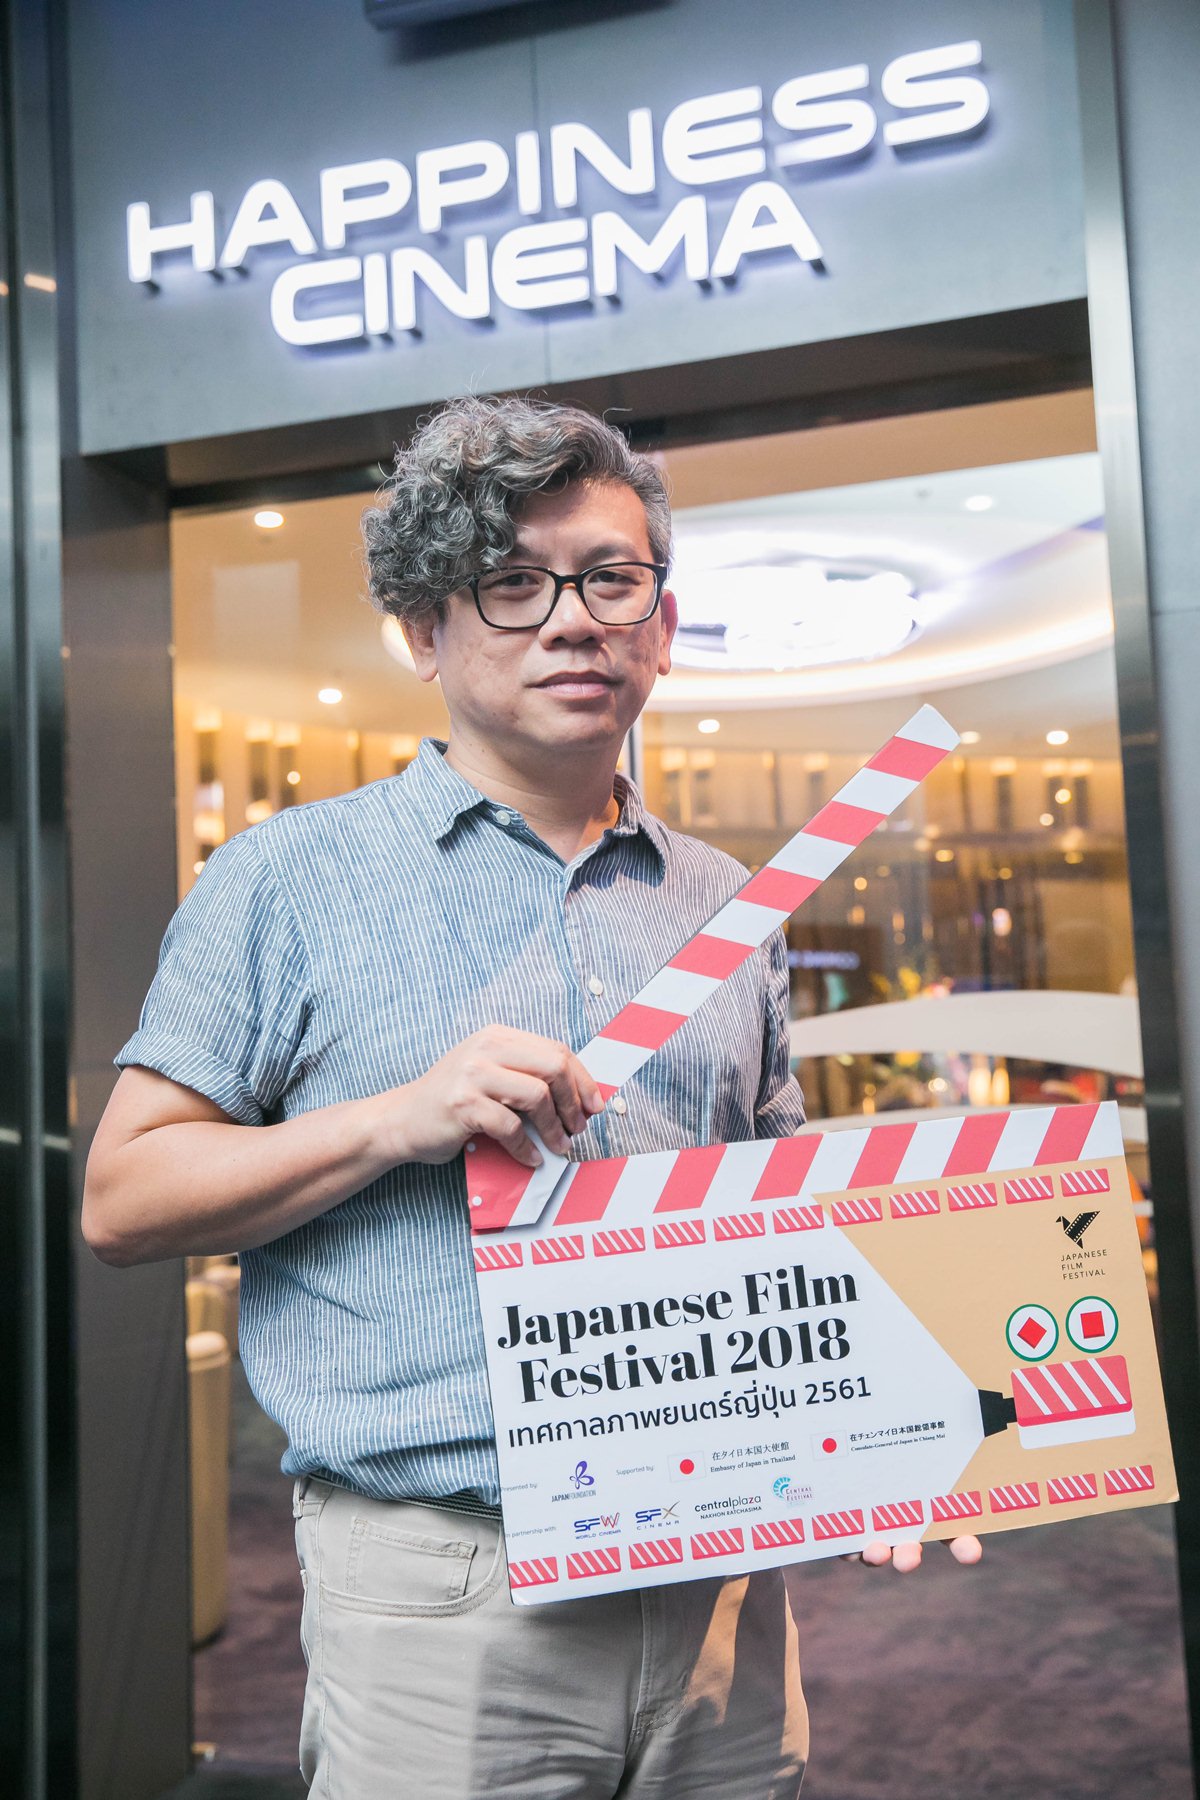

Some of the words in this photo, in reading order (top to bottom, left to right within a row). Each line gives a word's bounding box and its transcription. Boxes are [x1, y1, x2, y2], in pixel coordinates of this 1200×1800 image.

[127, 41, 990, 283] HAPPINESS
[270, 181, 823, 346] CINEMA
[1061, 1249, 1107, 1261] JAPANESE
[1062, 1262, 1083, 1271] FILM
[1063, 1269, 1106, 1280] FESTIVAL
[497, 1288, 734, 1356] Japanese
[741, 1264, 860, 1317] Film
[517, 1333, 719, 1404] Festival
[728, 1317, 852, 1374] 2018
[508, 1379, 797, 1448] เทศกาลภาพยนตร์ญี่ปุ่น
[806, 1376, 872, 1406] 2561
[712, 1441, 790, 1461] 在タイ日本国大使館
[710, 1465, 736, 1473] Embassy
[770, 1455, 796, 1464] Thailand
[695, 1495, 761, 1512] centralplaza
[700, 1511, 726, 1520] NAKHON
[726, 1506, 762, 1515] RATCHASIMA
